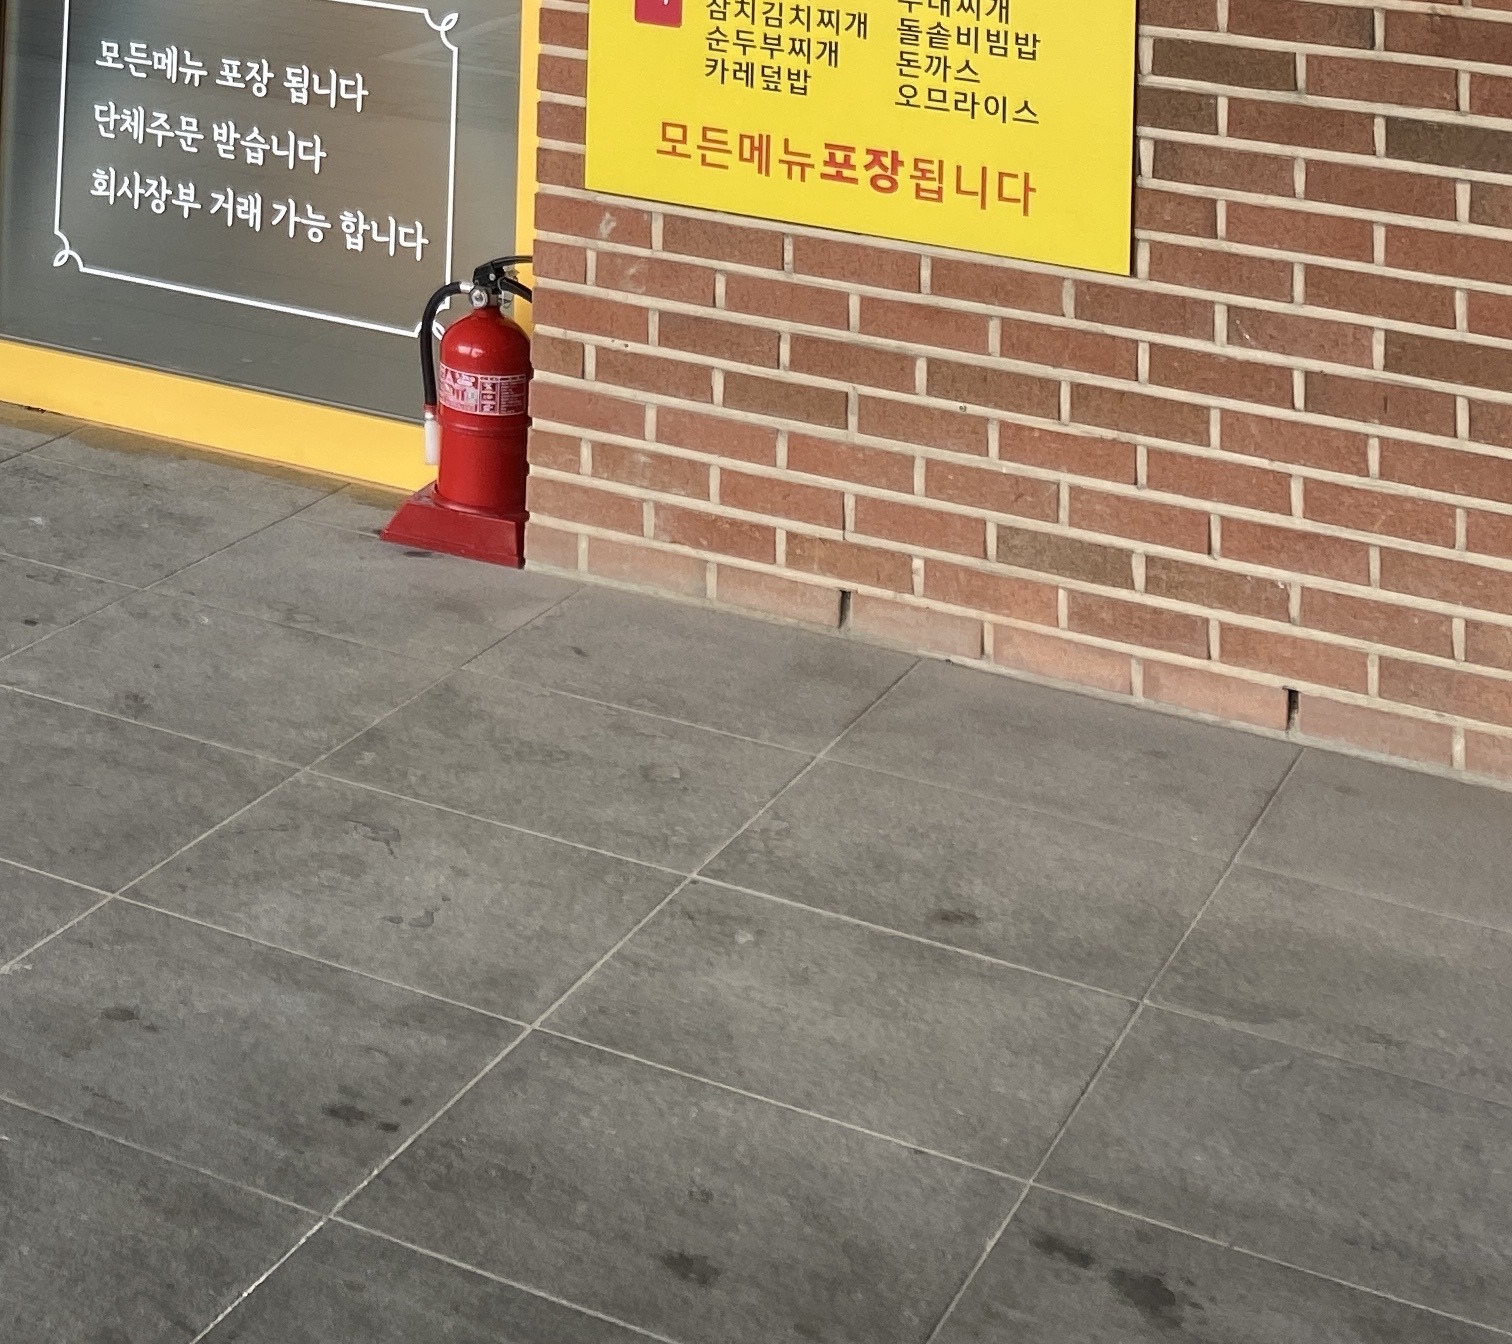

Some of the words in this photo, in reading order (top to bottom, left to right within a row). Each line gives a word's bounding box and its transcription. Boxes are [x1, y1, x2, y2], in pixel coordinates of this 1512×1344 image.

[704, 25, 839, 67] 순두부찌개
[896, 16, 1041, 61] 돌솥비빔밥
[94, 39, 208, 87] 모든메뉴
[215, 57, 275, 99] 포장
[282, 64, 370, 114] 됩니다
[704, 56, 811, 96] 카레덮밥
[895, 50, 981, 85] 돈까스
[894, 83, 1040, 124] 오므라이스
[93, 101, 205, 153] 단체주문
[211, 122, 327, 175] 받습니다
[656, 120, 1037, 217] 모든메뉴포장됩니다
[89, 166, 202, 219] 회사장부
[209, 186, 263, 233] 거래
[270, 198, 332, 244] 가능
[339, 209, 430, 262] 합니다
